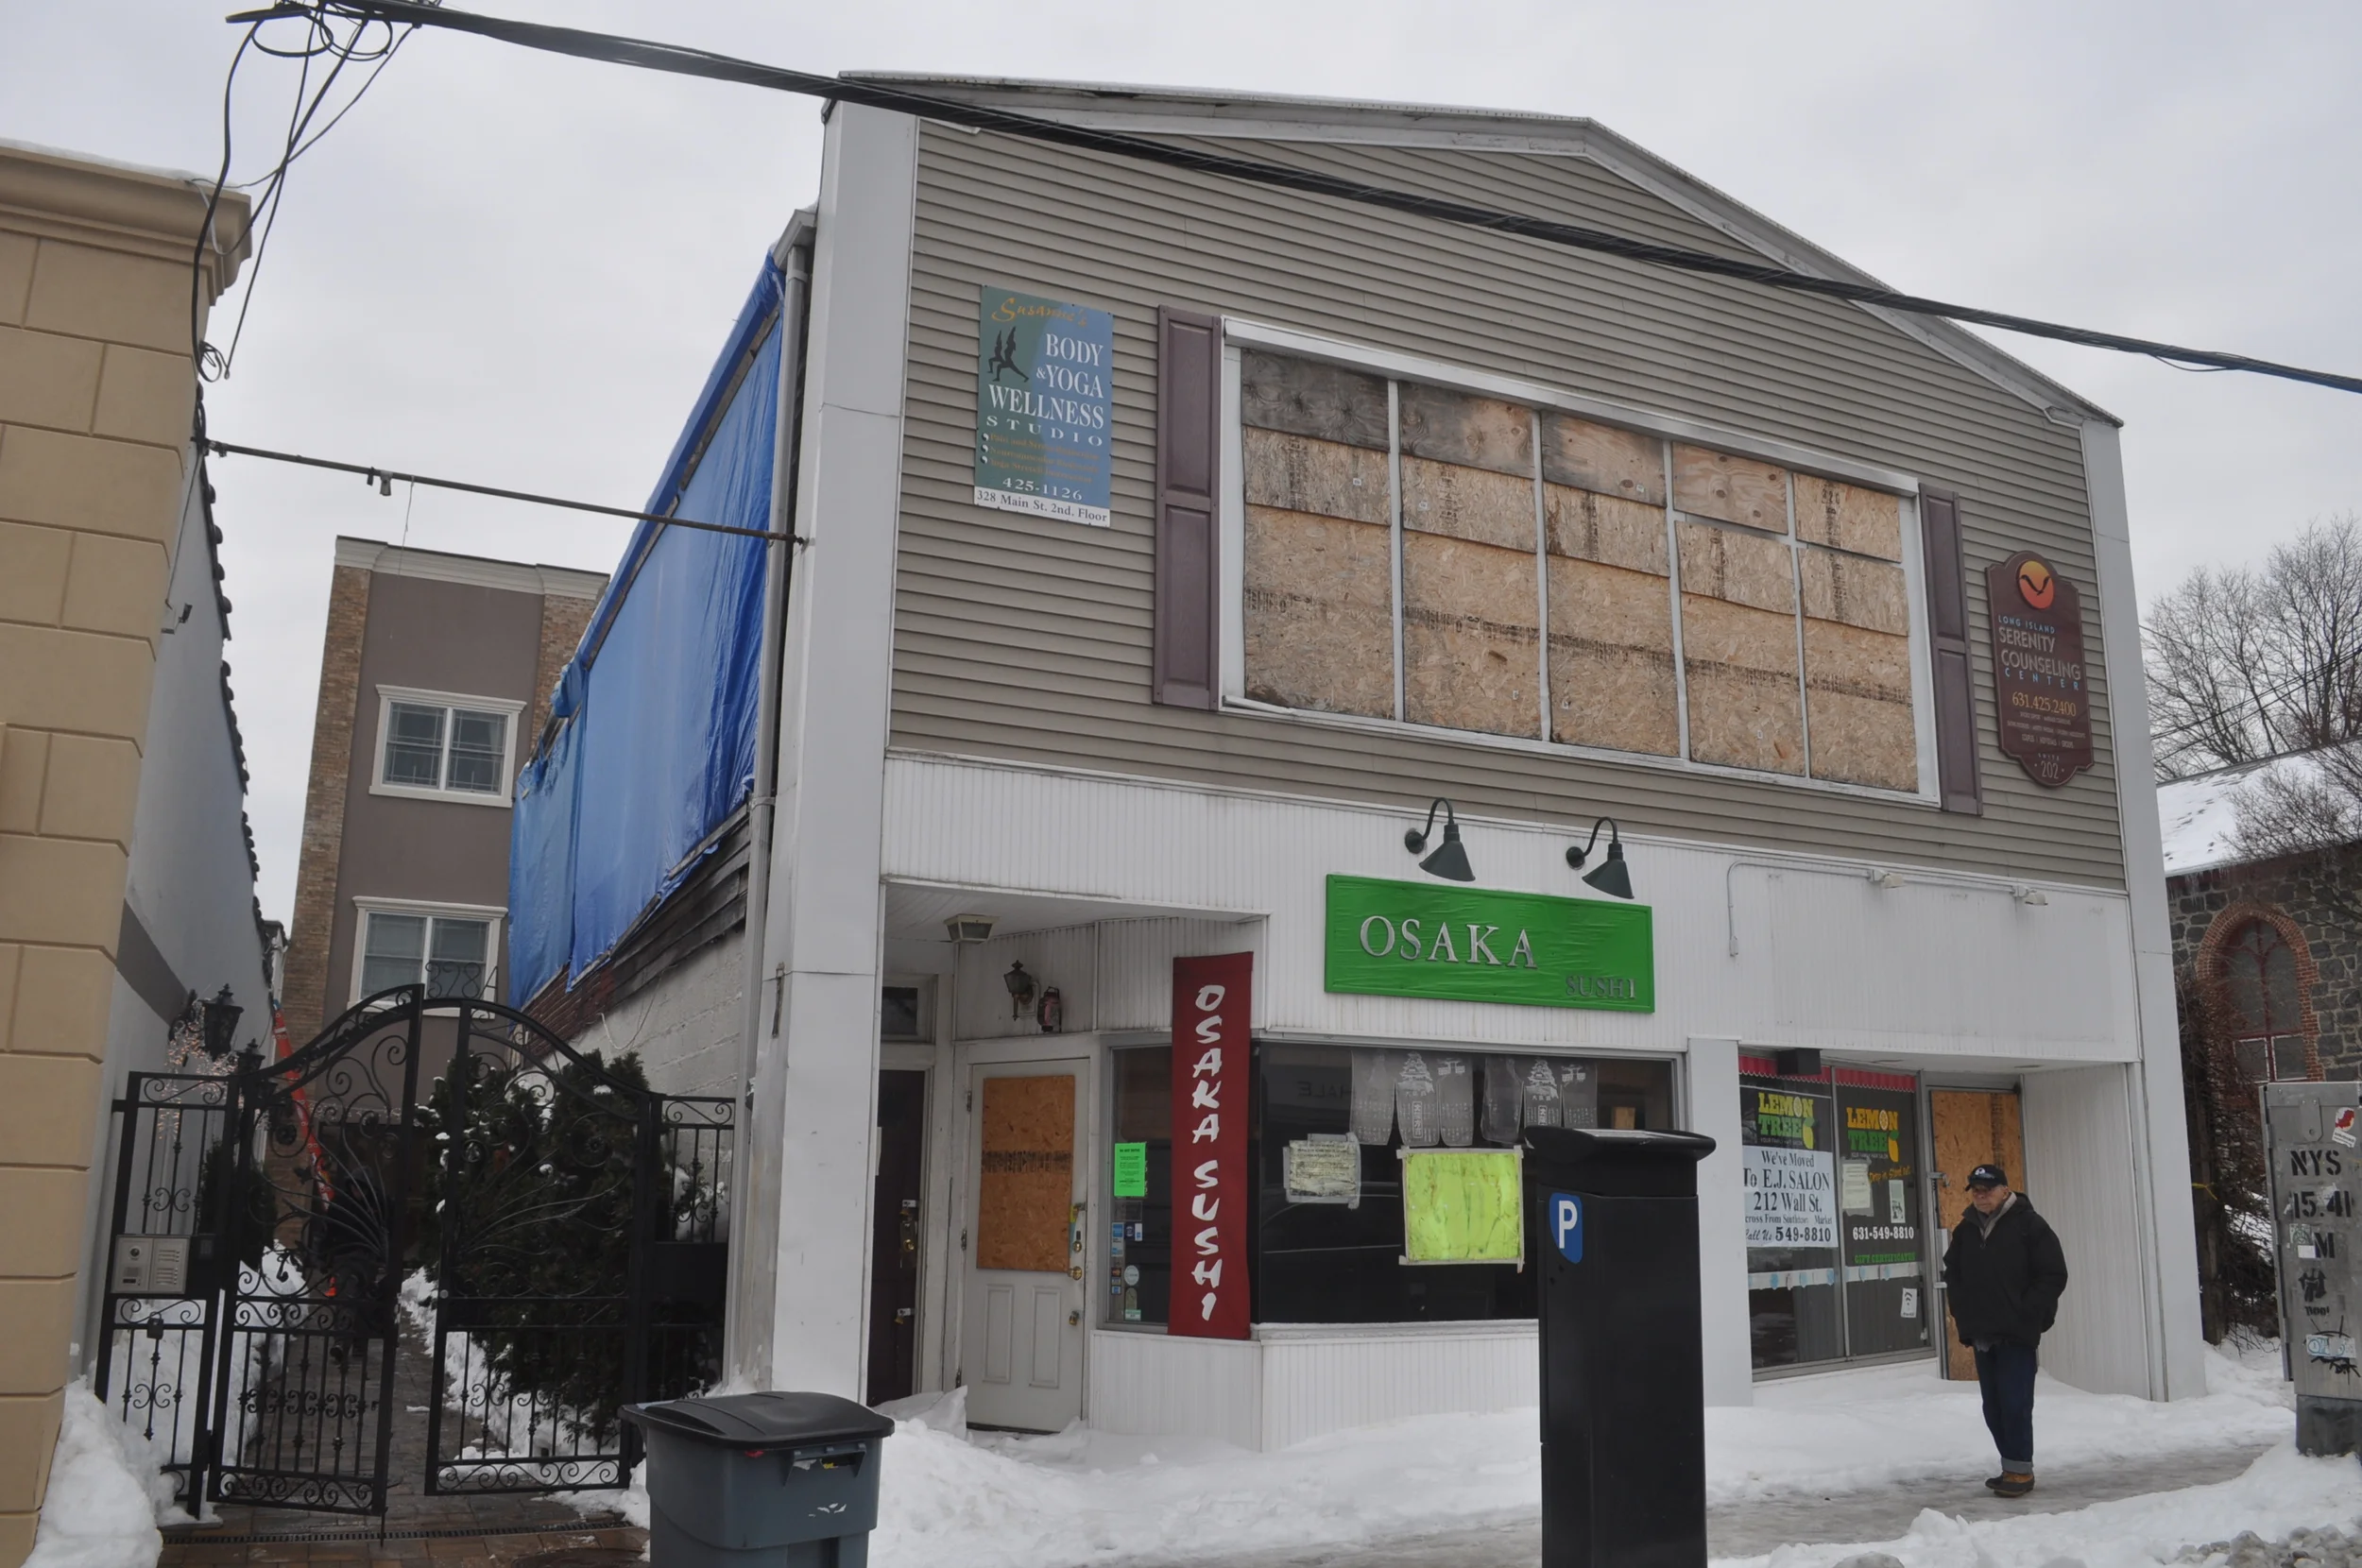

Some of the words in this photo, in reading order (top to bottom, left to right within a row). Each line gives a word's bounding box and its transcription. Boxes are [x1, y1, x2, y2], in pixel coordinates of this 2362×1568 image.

[1046, 333, 1104, 366] BODY
[988, 383, 1104, 429] WELLNESS
[986, 416, 1103, 447] STUDIO
[1002, 477, 1083, 501] 425-1126
[977, 489, 997, 503] 328
[1001, 494, 1029, 508] Main
[1033, 499, 1048, 512] St.
[1051, 503, 1074, 517] 2nd.
[1078, 508, 1107, 521] Floor
[1998, 615, 2021, 627] LONG
[2025, 621, 2055, 634] ISLAND
[1998, 626, 2056, 653] SERENITY
[2001, 649, 2081, 680] COUNSELING
[2005, 667, 2080, 690] CENTER
[2011, 691, 2077, 717] 631.425.2400
[2041, 760, 2059, 779] 202
[1360, 915, 1538, 969] OSAKA
[1566, 976, 1637, 999] SUSHI
[1192, 984, 1225, 1144] OSAKA
[1758, 1092, 1813, 1117] LEMON
[1758, 1114, 1802, 1138] TREE
[1846, 1107, 1899, 1131] LEMON
[1848, 1130, 1889, 1151] TREE
[1761, 1150, 1788, 1166] We've
[1789, 1152, 1814, 1167] Moved
[2290, 1150, 2342, 1176] NYS
[1743, 1167, 1757, 1187] To
[1762, 1168, 1787, 1188] E.J.
[1789, 1170, 1830, 1190] SALON
[1754, 1191, 1777, 1211] 212
[1781, 1192, 1806, 1212] Wall
[1808, 1193, 1822, 1213] St.
[2293, 1190, 2352, 1219] 15.41
[1559, 1200, 1578, 1249] P
[1765, 1214, 1781, 1223] From
[1191, 1159, 1223, 1321] SUSHI
[1855, 1254, 1870, 1264] GIFT
